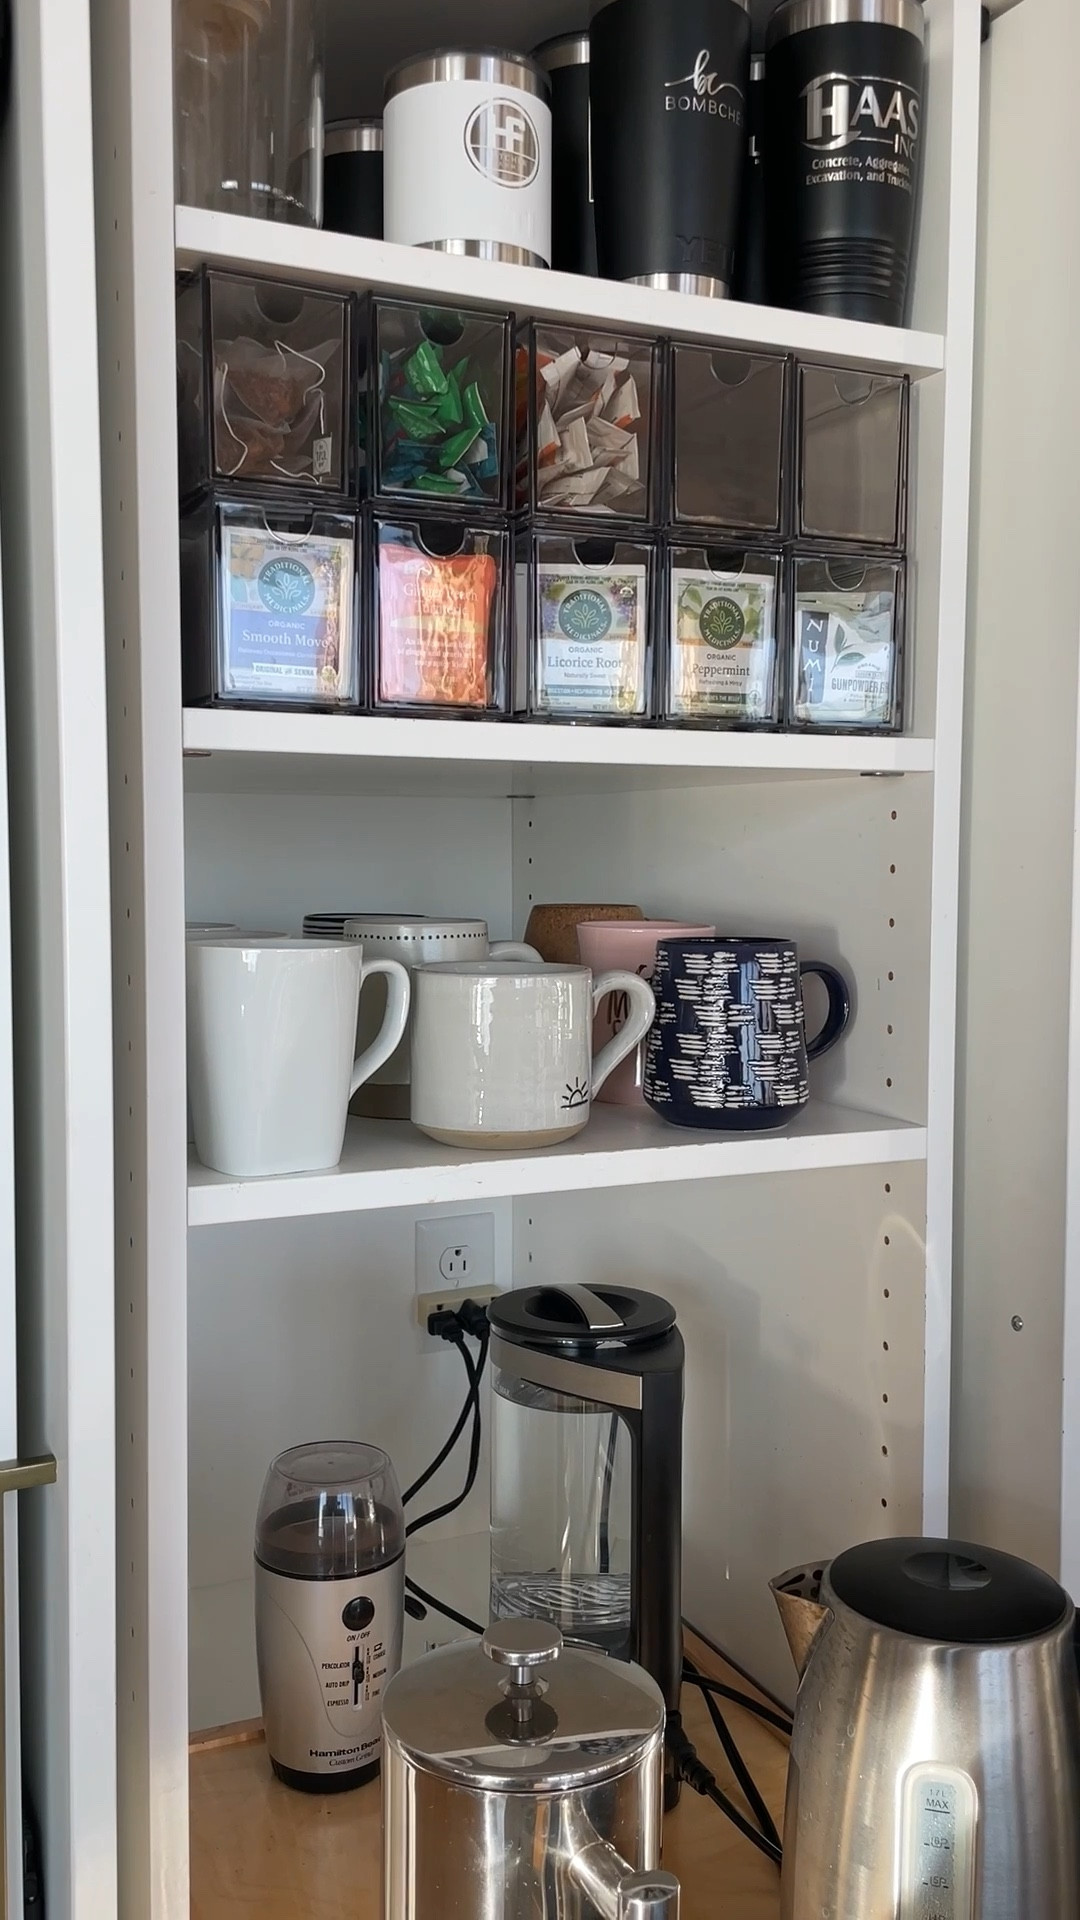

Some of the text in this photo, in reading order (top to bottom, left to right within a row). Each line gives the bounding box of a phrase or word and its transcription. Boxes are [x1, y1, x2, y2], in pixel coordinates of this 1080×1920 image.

[665, 96, 743, 127] BOMBCHE
[806, 84, 919, 140] HAAS
[895, 133, 916, 162] INC
[811, 156, 863, 170] Concrete,
[805, 170, 863, 185] Excavation,
[866, 171, 885, 183] and
[263, 562, 311, 585] TRADITIONAL
[563, 593, 607, 614] TRADITIONAL
[703, 601, 741, 620] TRADITIONAL
[268, 619, 306, 630] ORGANIC
[242, 629, 329, 648] Smooth Move
[568, 646, 604, 654] ORGANIC
[547, 656, 623, 669] Licorice Root
[706, 653, 737, 661] ORGANIC
[693, 663, 751, 678] Peppermint
[831, 678, 879, 694] GUNPOWDER
[360, 1631, 371, 1639] OFF
[321, 1662, 350, 1670] PERCOLATOR
[339, 1680, 350, 1688] DRIP
[327, 1698, 350, 1707] ESPRESSO
[309, 1746, 360, 1757] Hamilton
[329, 1757, 355, 1767] Custom
[925, 1798, 949, 1810] MAX
